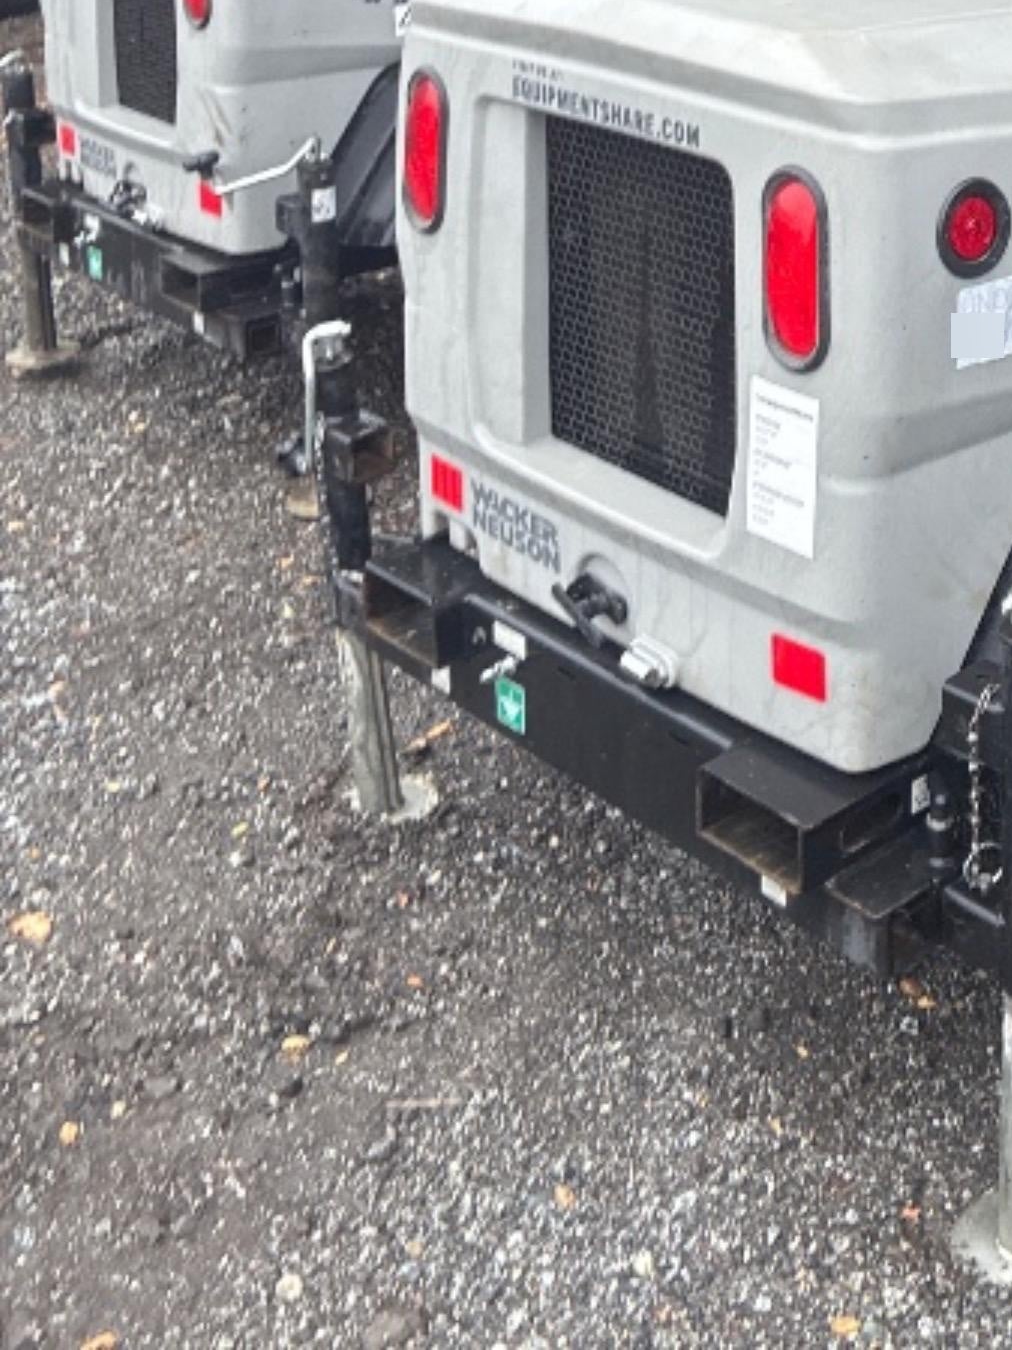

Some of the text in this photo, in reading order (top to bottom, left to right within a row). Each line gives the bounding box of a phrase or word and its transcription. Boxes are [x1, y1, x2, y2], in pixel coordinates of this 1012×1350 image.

[512, 74, 701, 147] EQUIPMENTSHARE.COM
[470, 478, 558, 539] WACKER
[473, 505, 560, 573] NEUSON
